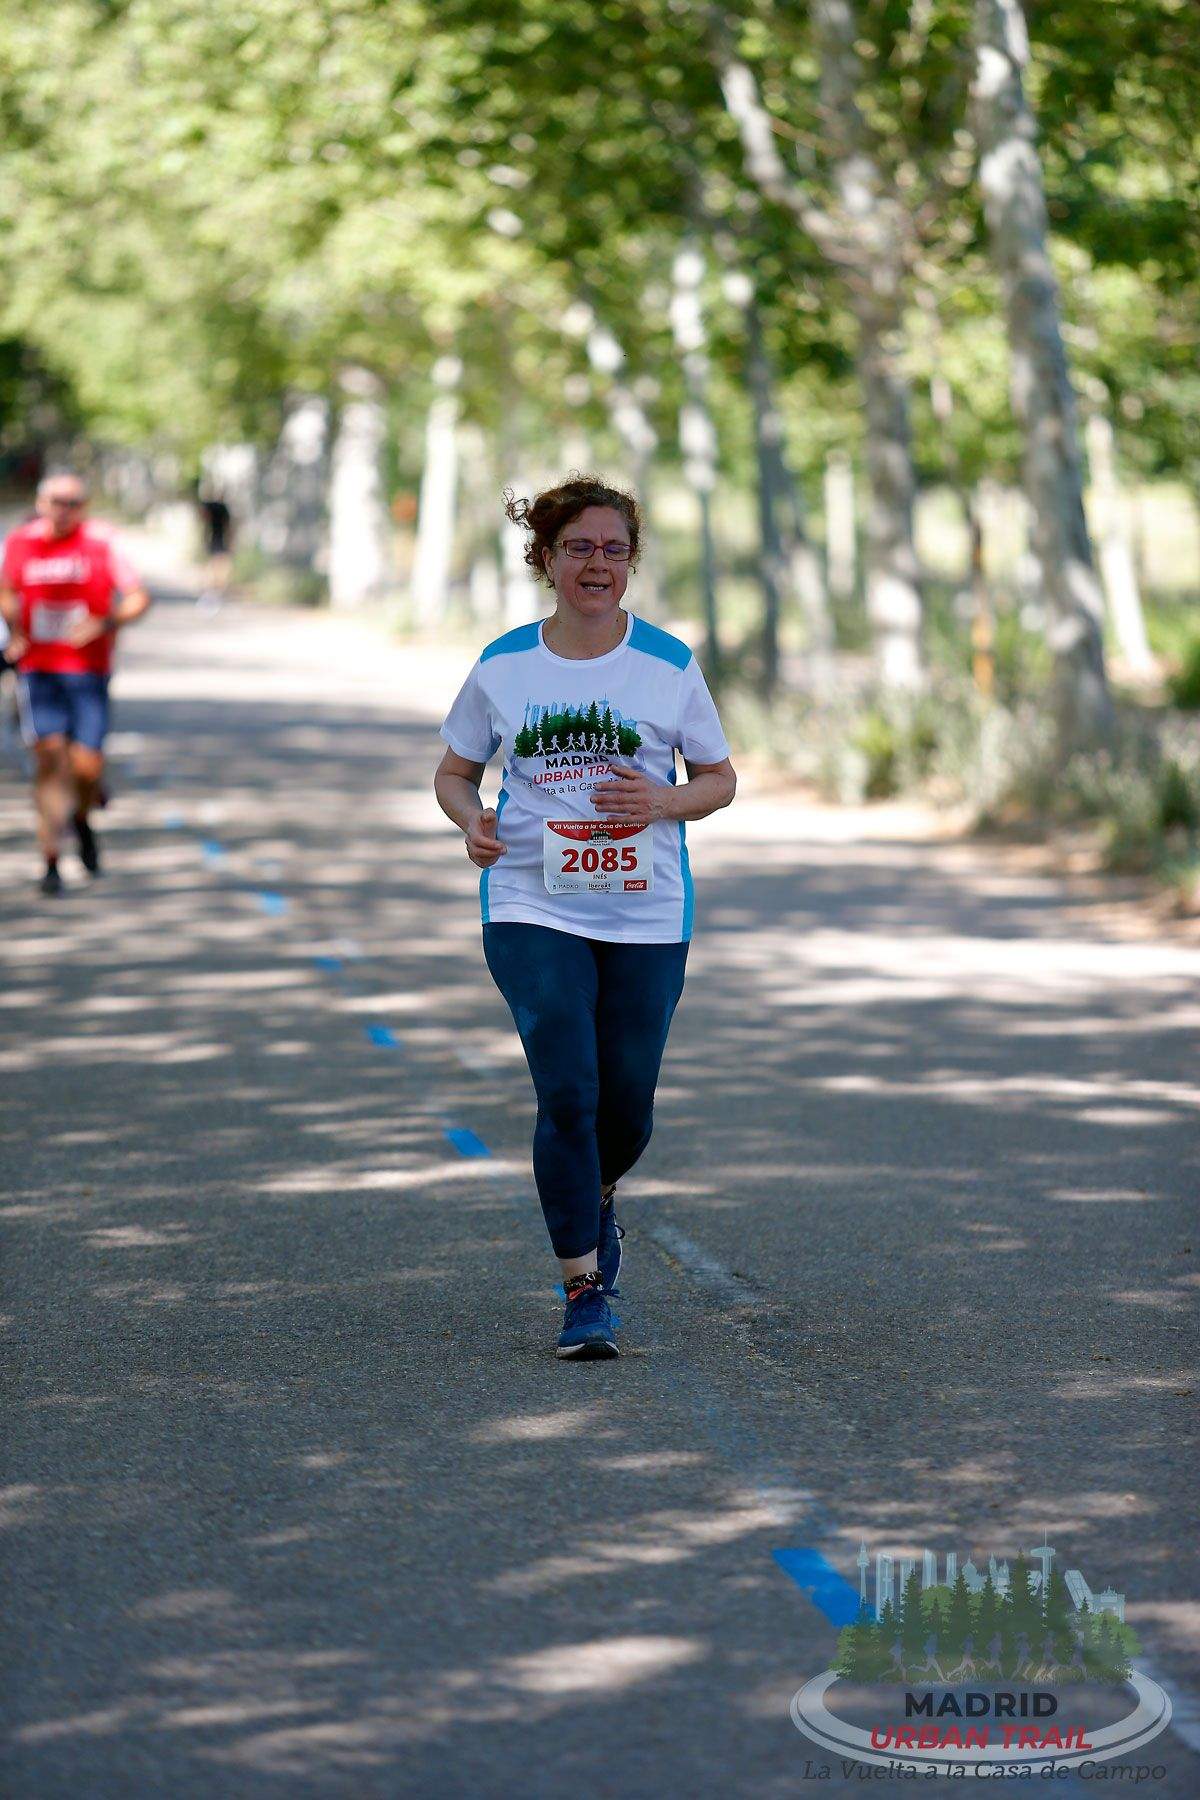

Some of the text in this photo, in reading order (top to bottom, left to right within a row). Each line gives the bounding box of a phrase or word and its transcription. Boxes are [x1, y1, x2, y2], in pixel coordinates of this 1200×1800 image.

[545, 755, 609, 769] MADRID
[534, 764, 613, 784] URBAN TRA
[568, 784, 576, 793] la
[580, 782, 597, 791] Cas
[561, 846, 638, 873] 2085
